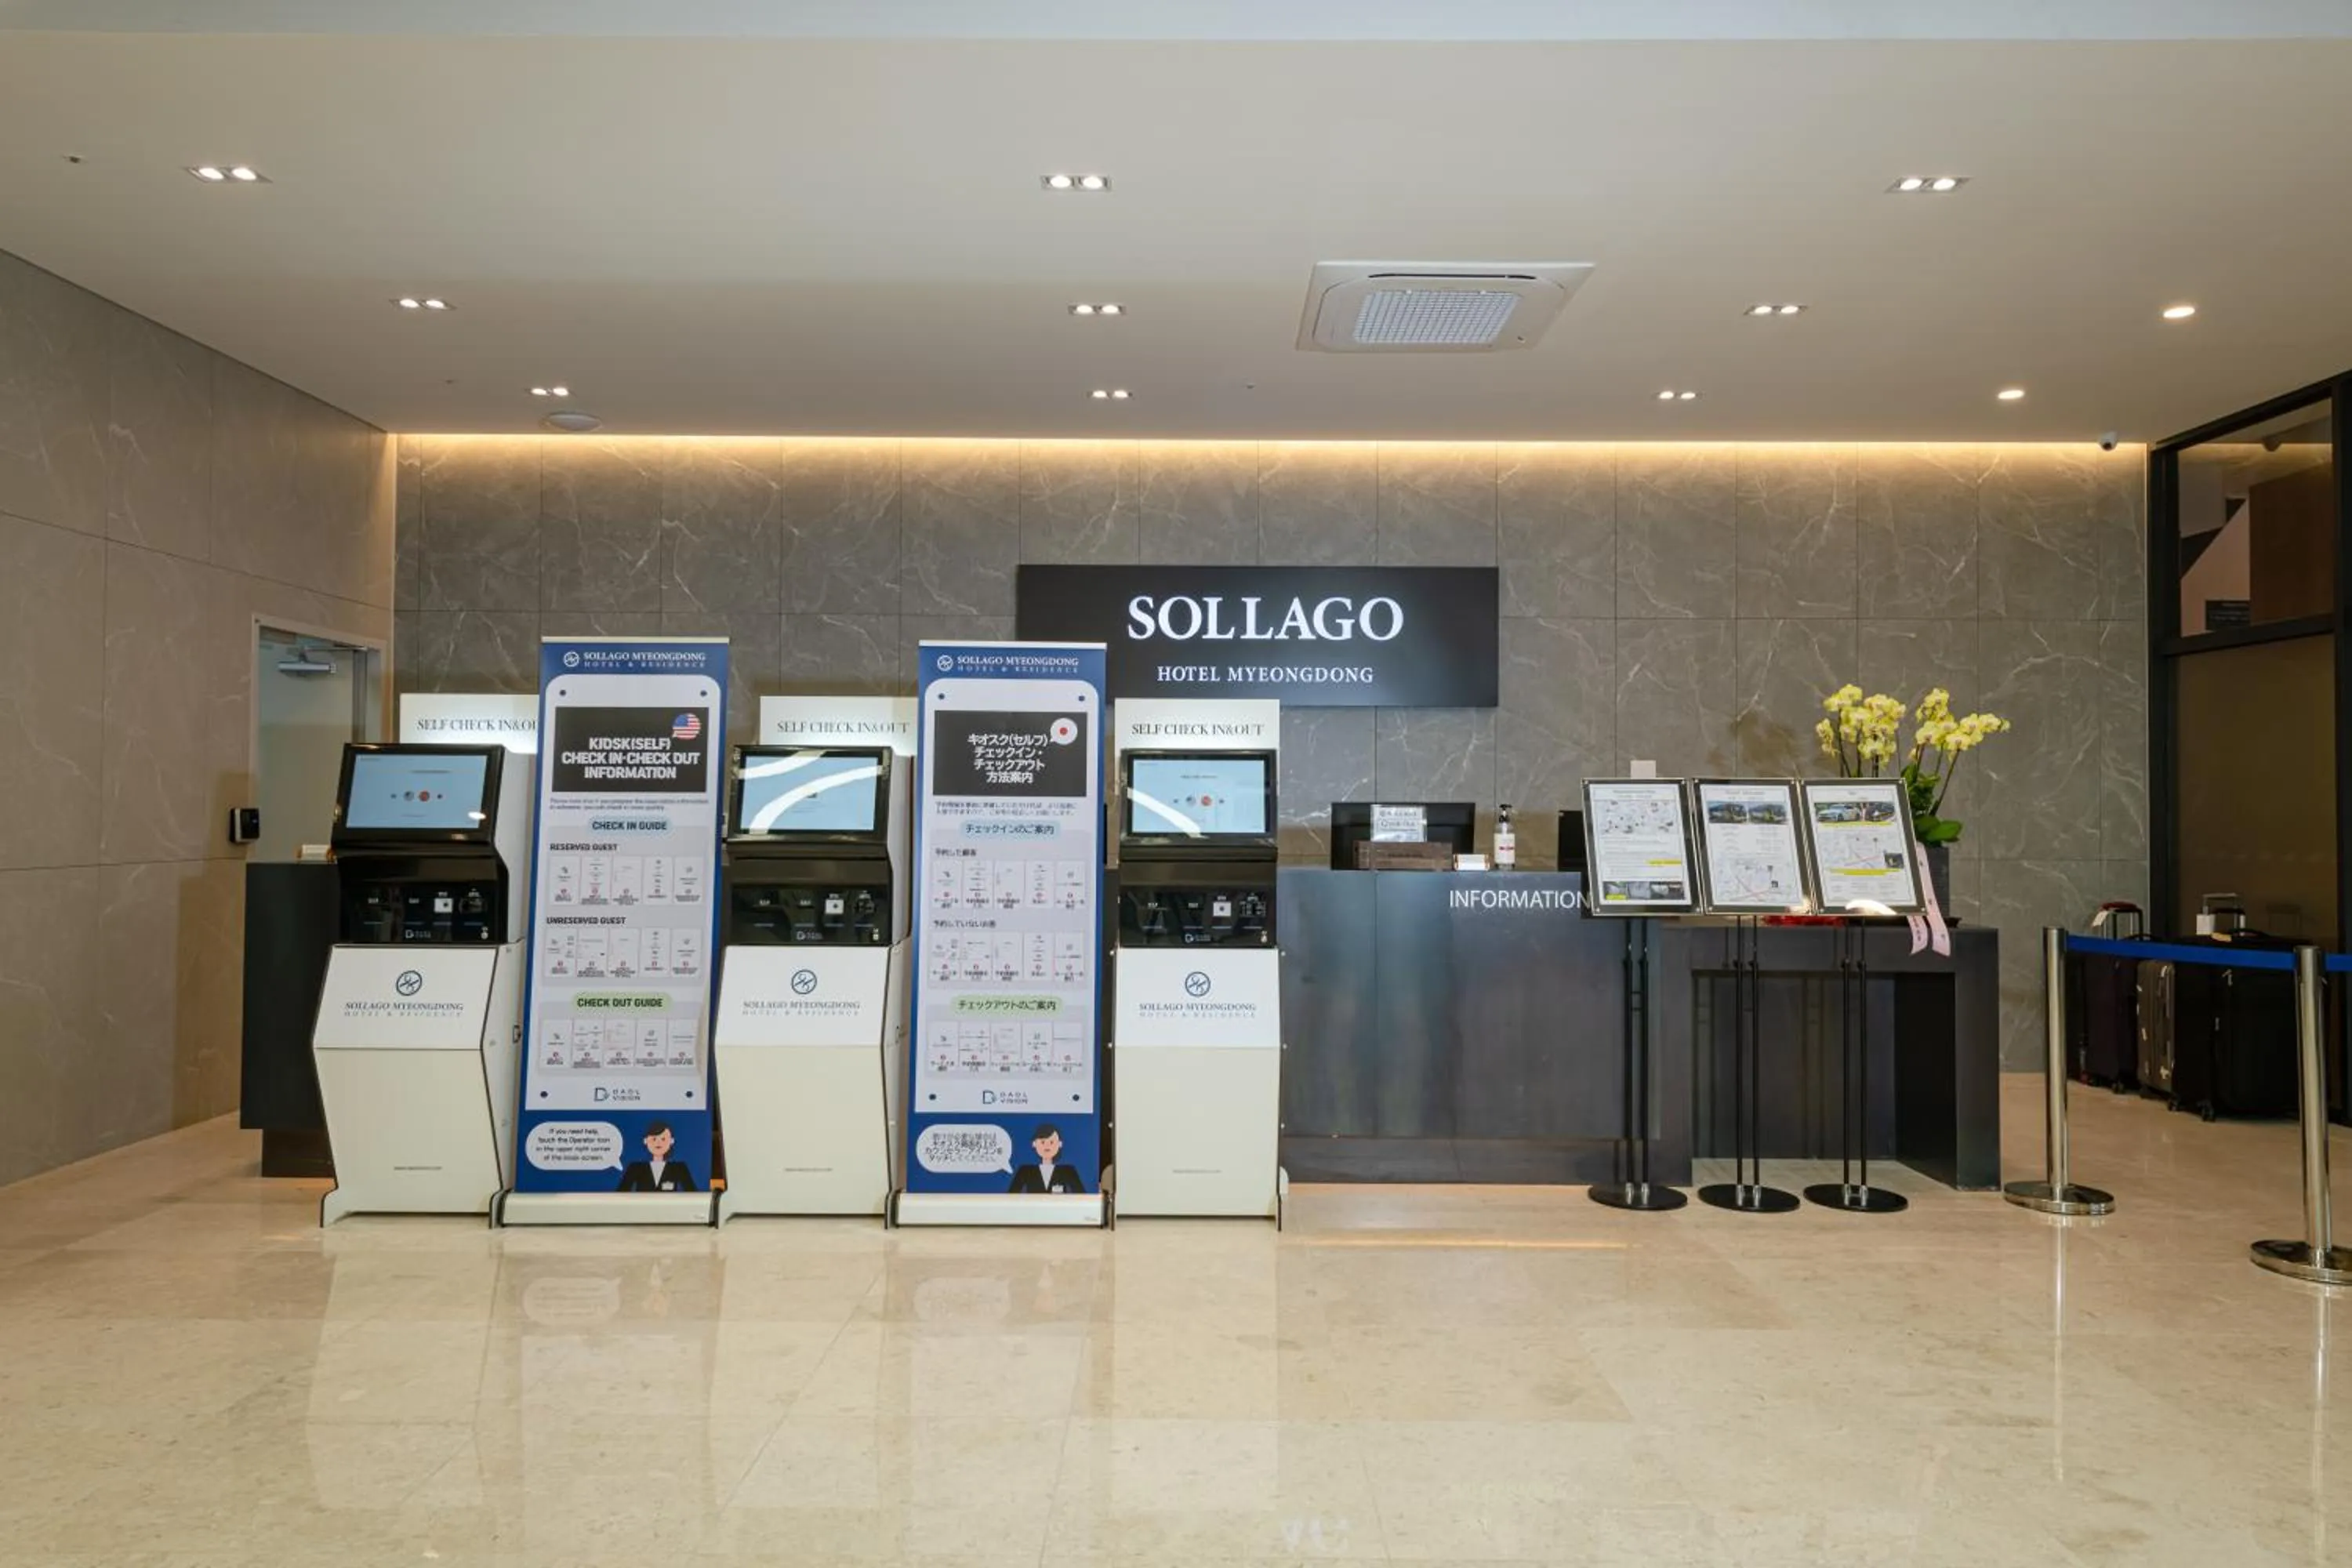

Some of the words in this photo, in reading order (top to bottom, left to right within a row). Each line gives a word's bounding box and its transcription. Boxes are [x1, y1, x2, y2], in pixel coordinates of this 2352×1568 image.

[1127, 596, 1404, 641] SOLLAGO
[583, 652, 630, 661] SOLLAGO
[632, 652, 706, 661] MYEONGDONG
[957, 656, 1004, 665] SOLLAGO
[1006, 657, 1079, 666] MYEONGDONG
[1157, 665, 1221, 682] HOTEL
[1227, 666, 1374, 684] MYEONGDONG
[417, 719, 448, 731] SELF
[451, 719, 495, 731] CHECK
[499, 719, 535, 731] IN&O
[777, 721, 808, 733] SELF
[810, 721, 854, 733] CHECK
[1131, 724, 1162, 735] SELF
[1164, 724, 1208, 735] CHECK
[1213, 724, 1265, 736] IN&OUT
[967, 733, 1048, 746] キオスク(セルフ)
[561, 752, 609, 765] CHECK
[673, 752, 701, 765] OUT
[974, 759, 1045, 771] チェックアウト
[584, 766, 677, 779] INFORMATION
[985, 771, 1033, 784] 方法案内
[592, 821, 625, 830] CHECK
[627, 821, 637, 830] IN
[639, 821, 667, 830] GUIDE
[965, 825, 1054, 835] チェックインのご案内
[1450, 890, 1591, 909] INFORMATION
[577, 998, 609, 1007] CHECK
[612, 998, 632, 1007] OUT
[634, 998, 662, 1007] GUIDE
[743, 1000, 787, 1009] SOLLAGO
[957, 1000, 1056, 1011] チェックアウトのご案内
